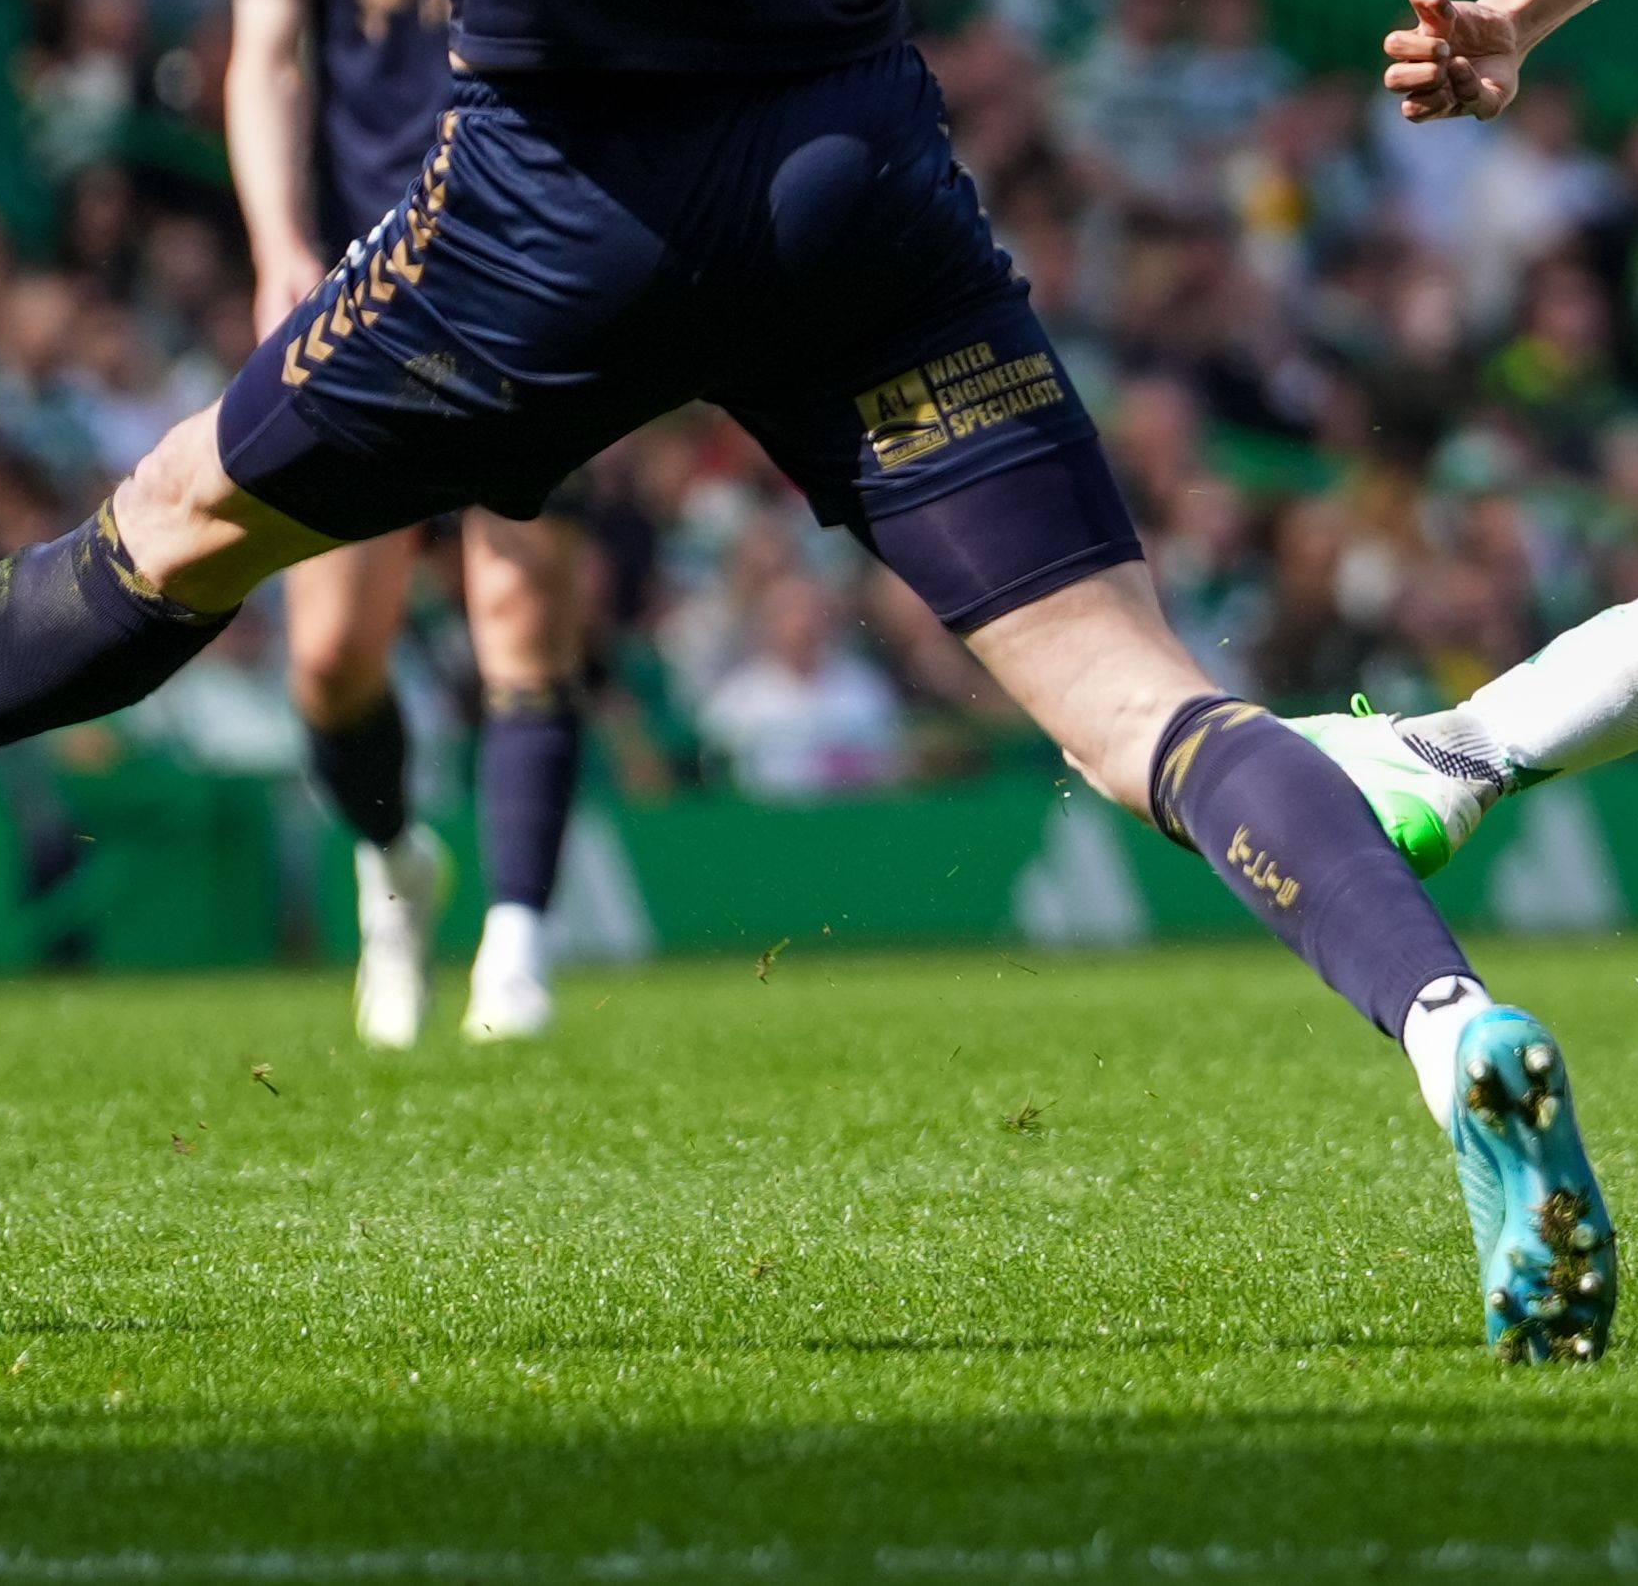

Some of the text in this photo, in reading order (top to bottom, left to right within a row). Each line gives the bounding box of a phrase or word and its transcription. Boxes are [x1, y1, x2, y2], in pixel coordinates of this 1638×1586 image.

[923, 341, 996, 387] WATER
[936, 351, 1055, 414] ENGINEERING
[948, 378, 1065, 439] SPECIALISTS
